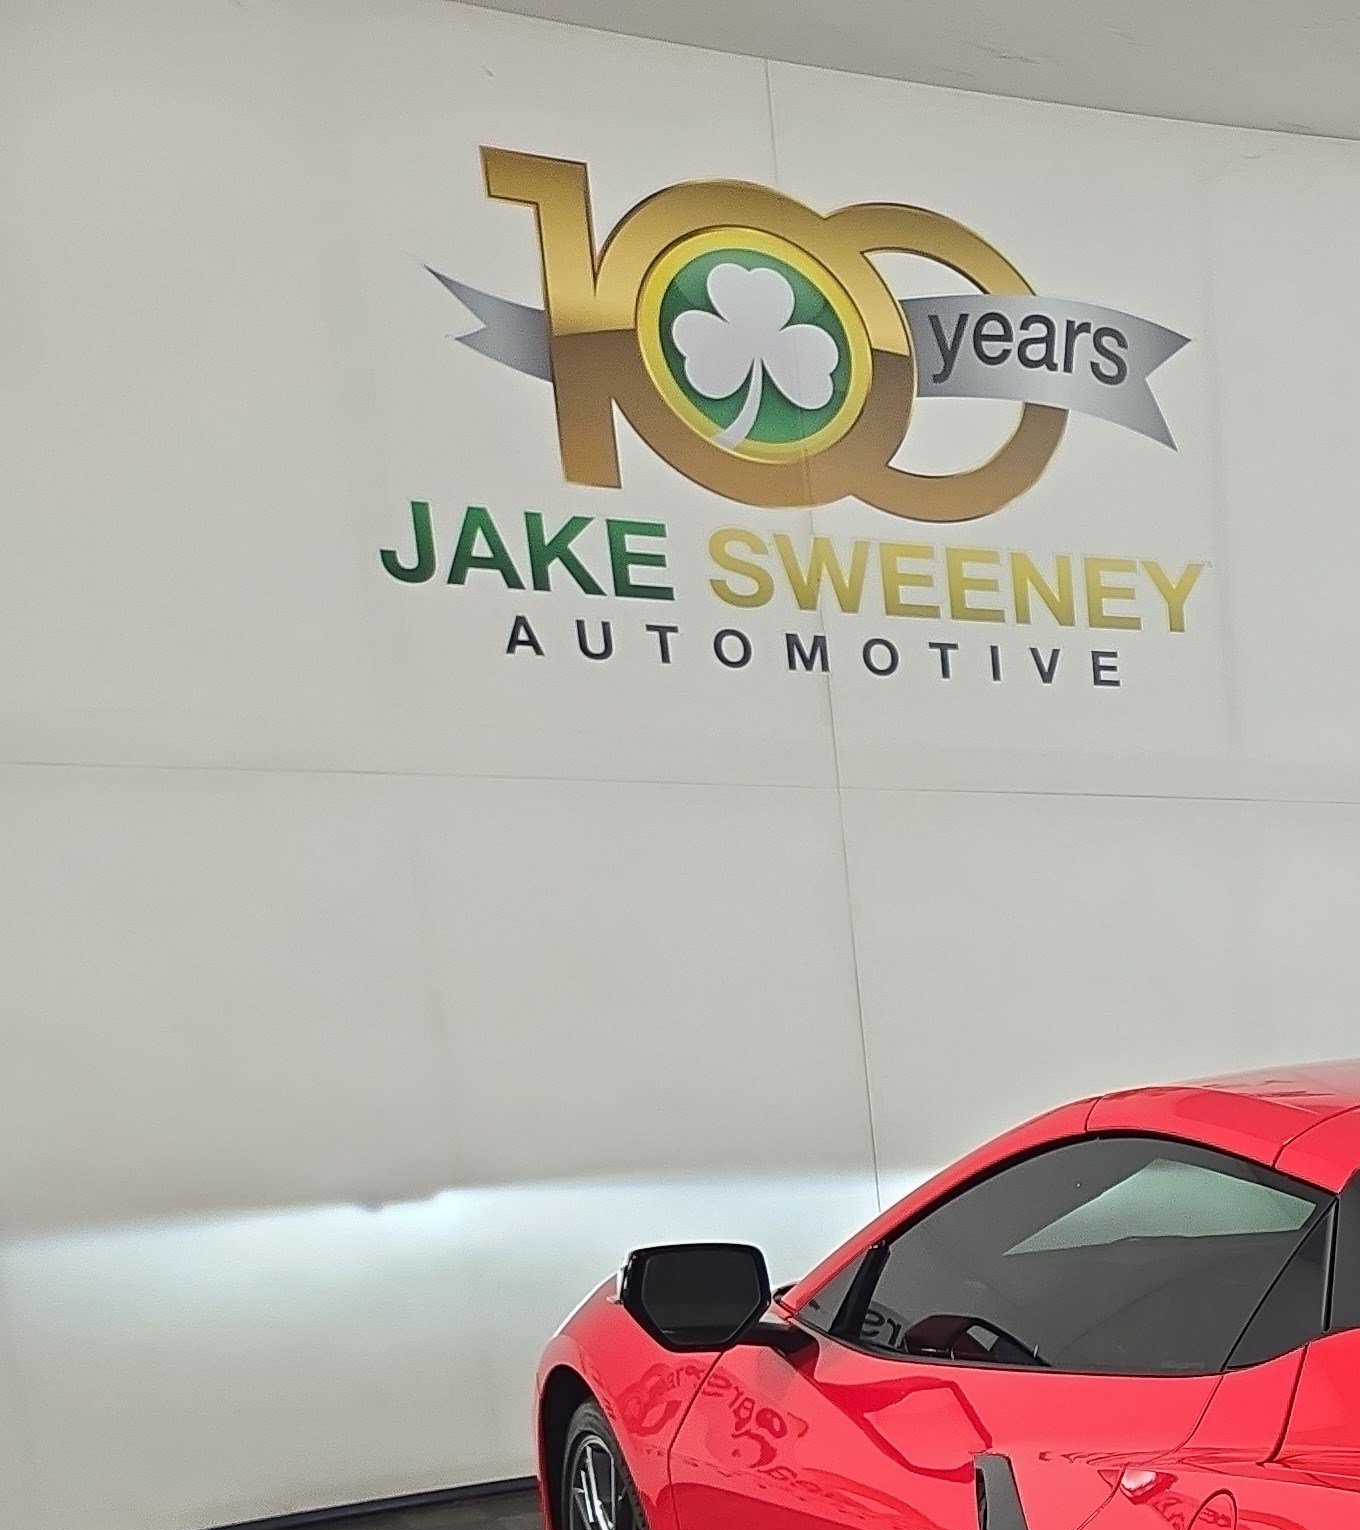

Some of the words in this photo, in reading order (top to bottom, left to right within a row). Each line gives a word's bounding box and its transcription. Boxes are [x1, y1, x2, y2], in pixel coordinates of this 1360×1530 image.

[479, 145, 1068, 523] 100
[929, 312, 1130, 387] years
[379, 500, 676, 602] JAKE
[706, 528, 1204, 634] SWEENEY
[505, 614, 1122, 689] AUTOMOTIVE
